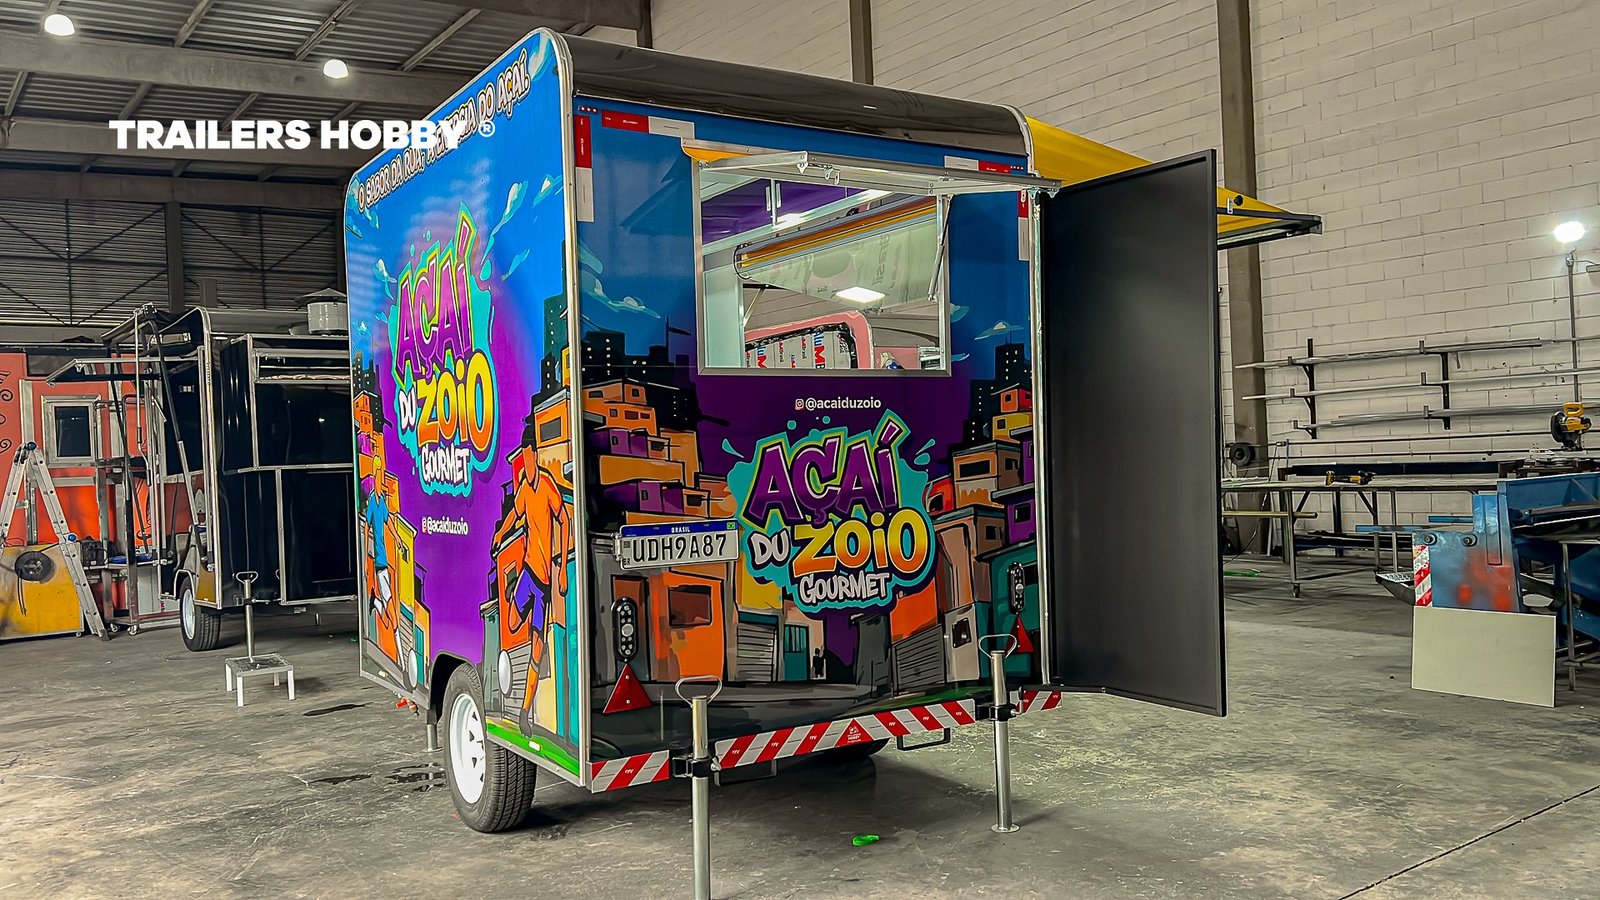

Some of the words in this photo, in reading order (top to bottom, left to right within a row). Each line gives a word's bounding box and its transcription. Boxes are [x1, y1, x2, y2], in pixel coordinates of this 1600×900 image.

[358, 183, 366, 212] O
[366, 163, 392, 207] SABOR
[391, 154, 403, 190] DA
[478, 83, 495, 121] DO
[399, 386, 417, 432] DU
[805, 396, 882, 410] @acaiduzoio
[421, 446, 470, 484] GOURMET
[426, 515, 469, 536] @acaiduzoio
[632, 533, 727, 562] UDH9A87
[751, 531, 789, 565] DU
[800, 570, 890, 604] GOURMET
